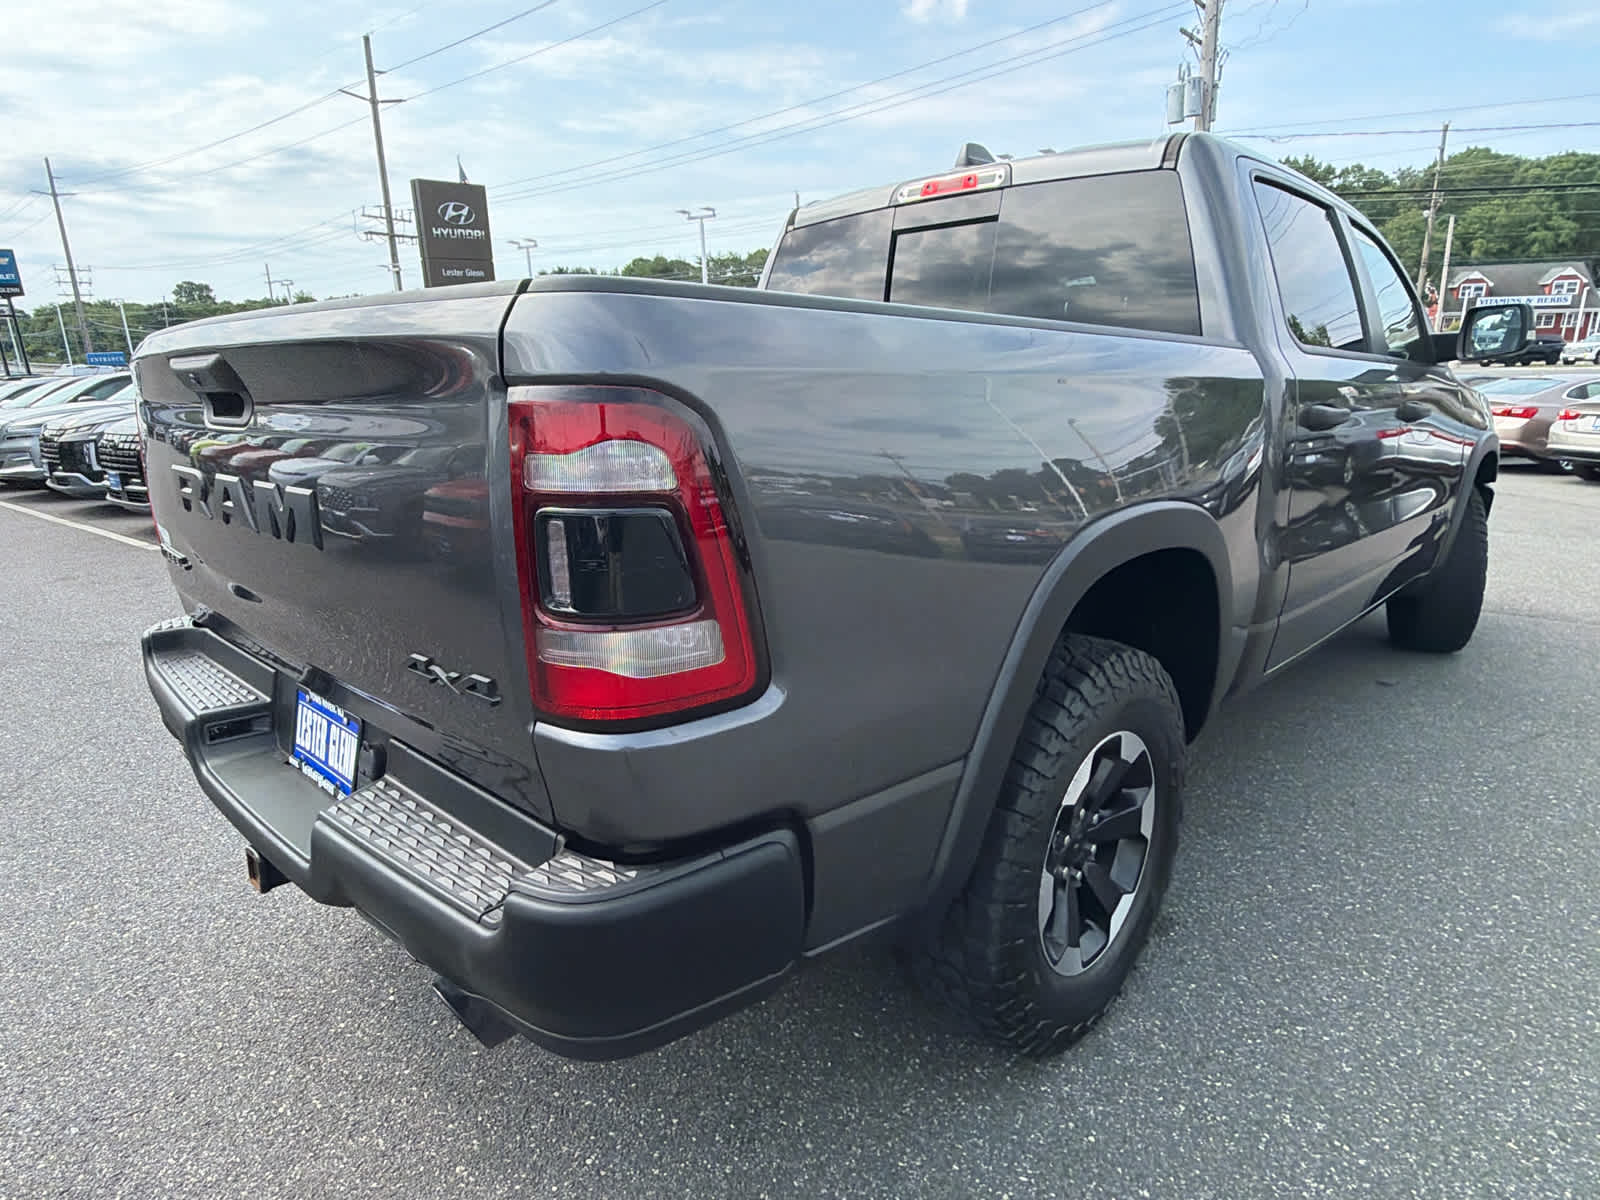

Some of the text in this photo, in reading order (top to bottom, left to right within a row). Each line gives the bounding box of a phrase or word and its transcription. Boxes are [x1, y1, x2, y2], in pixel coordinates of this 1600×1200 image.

[432, 227, 485, 240] HYUNDAI
[442, 268, 485, 278] Lester Glenn
[1537, 296, 1568, 304] HERBS
[171, 464, 324, 551] RAM
[296, 702, 328, 762] LESTER
[328, 723, 358, 782] GLENN
